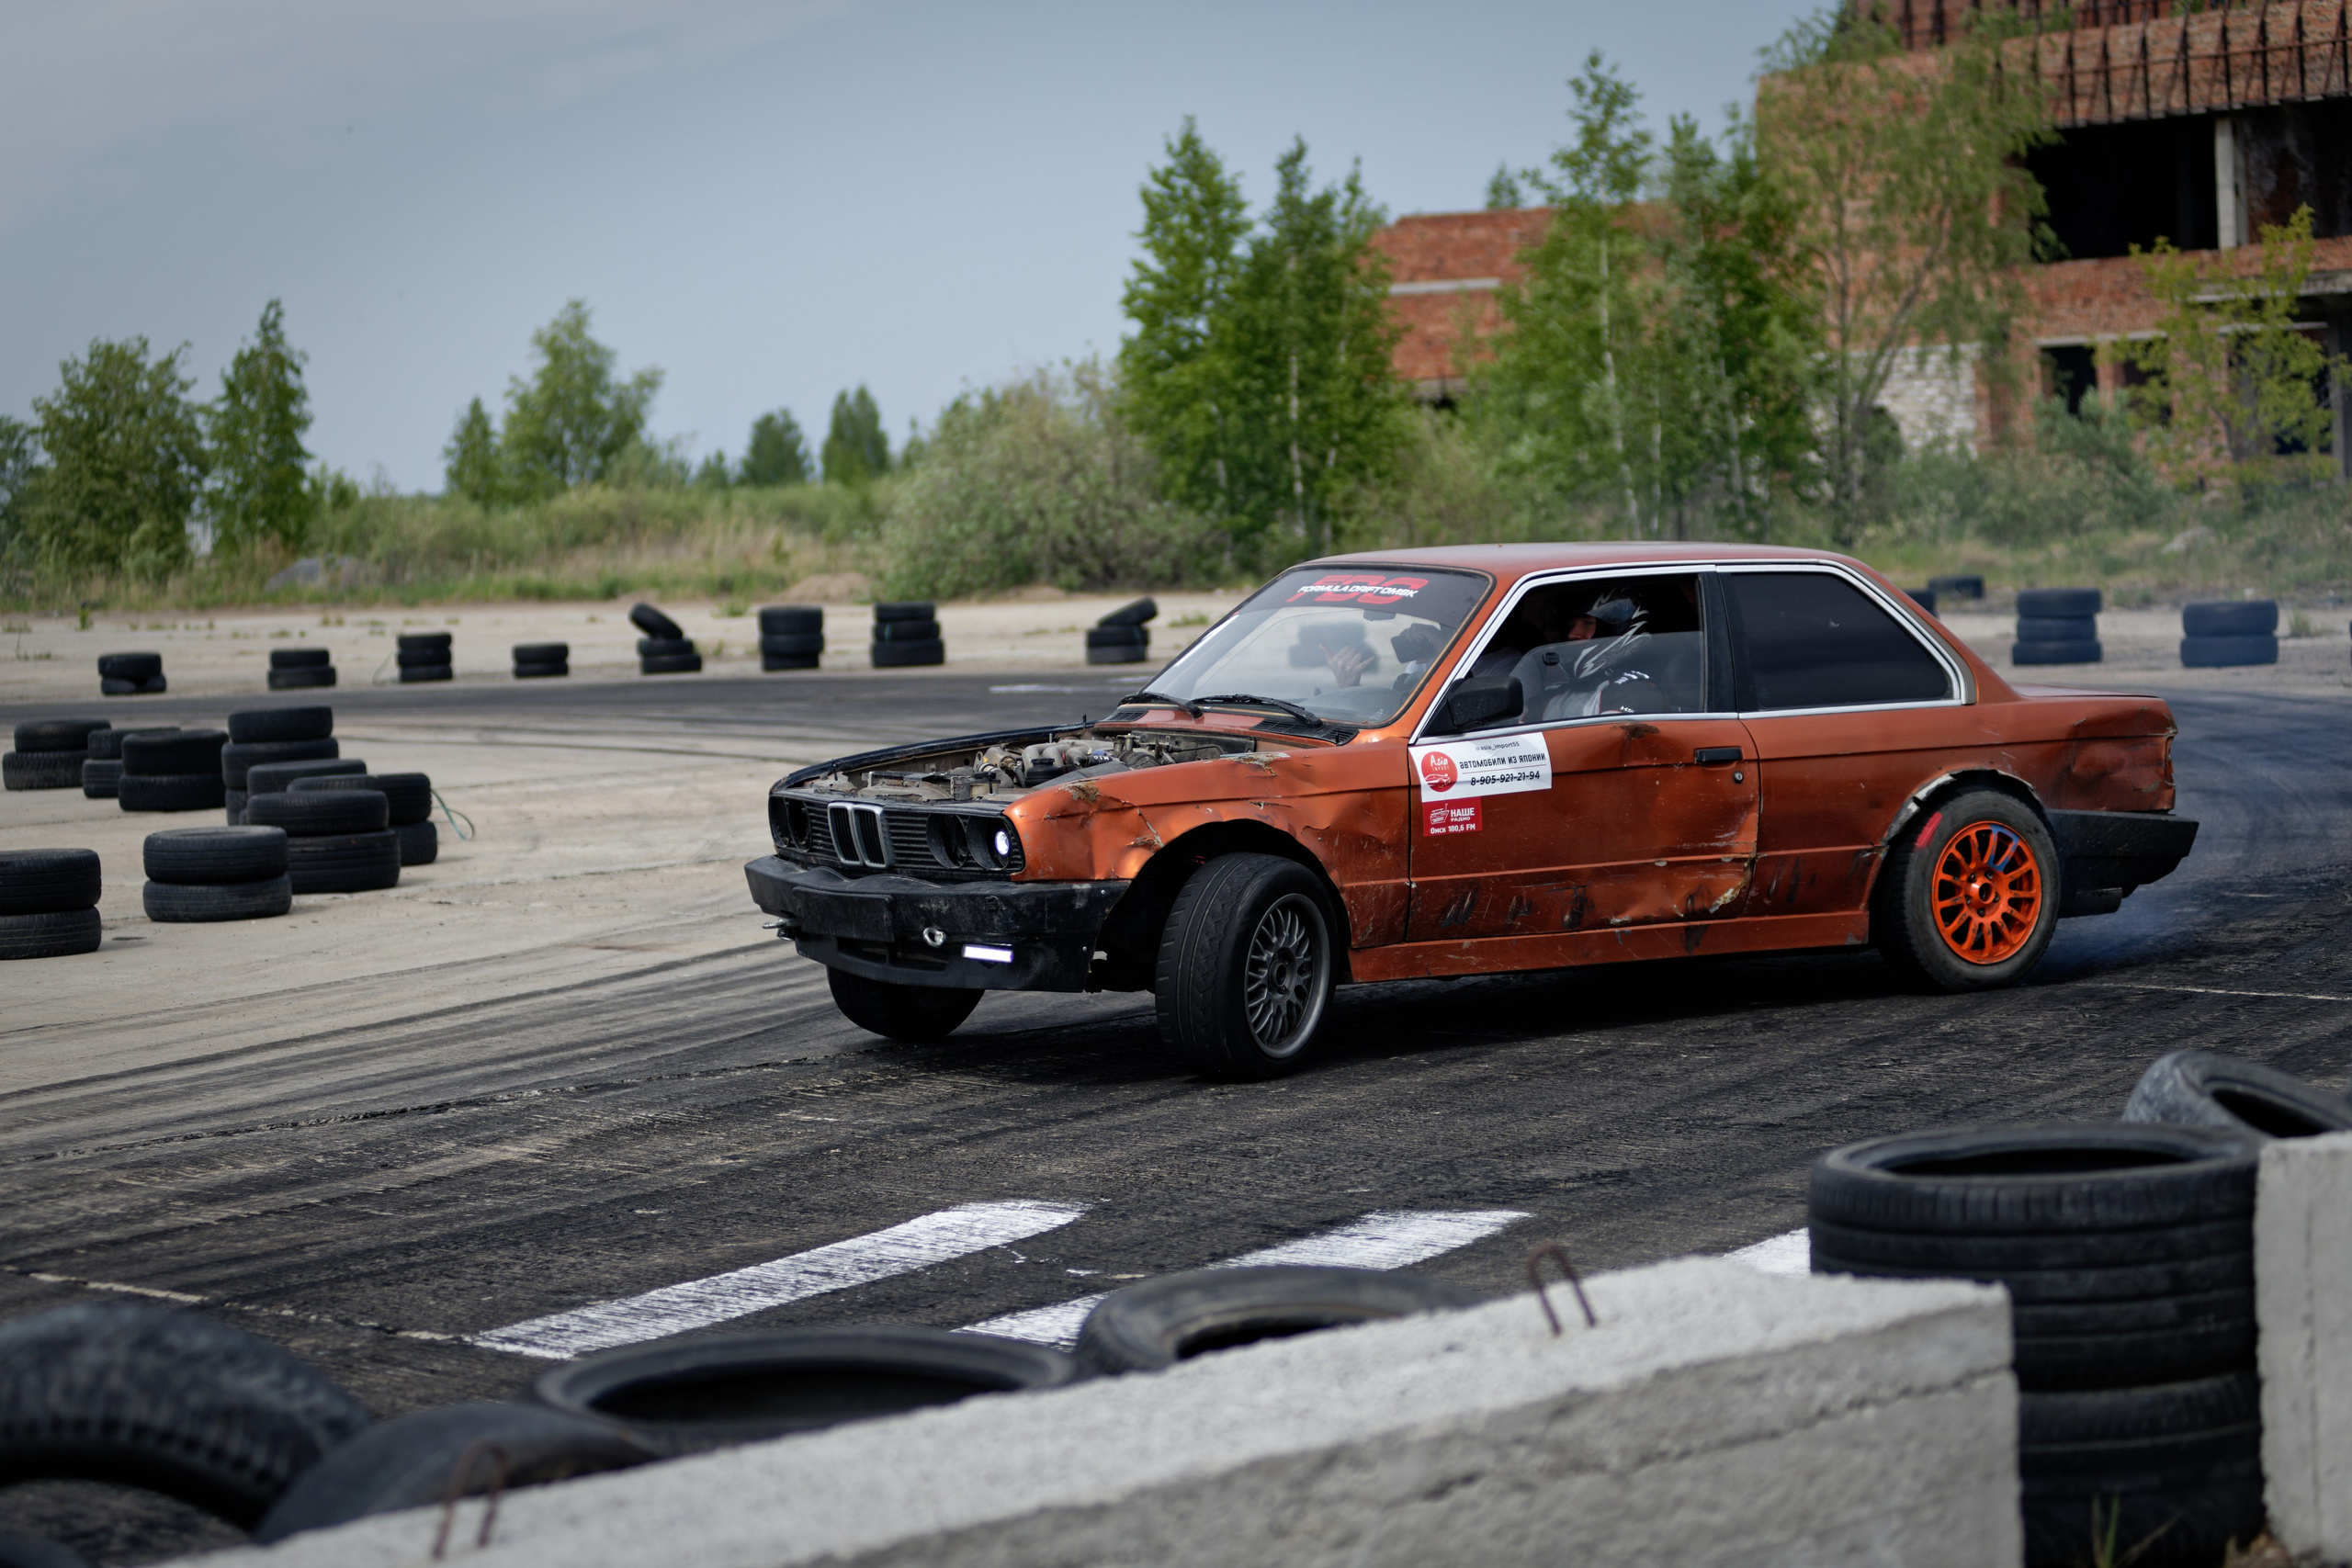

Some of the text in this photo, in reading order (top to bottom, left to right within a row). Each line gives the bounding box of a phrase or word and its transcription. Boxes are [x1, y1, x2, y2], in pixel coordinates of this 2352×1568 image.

[1297, 584, 1419, 597] FORMULA DRIFT OMSK
[1430, 754, 1449, 767] Asia
[1508, 755, 1518, 764] ИЗ
[1520, 752, 1546, 763] ЯПОНИИ
[1470, 771, 1541, 786] 8-905-921-21-94
[1450, 807, 1476, 818] НАШЕ
